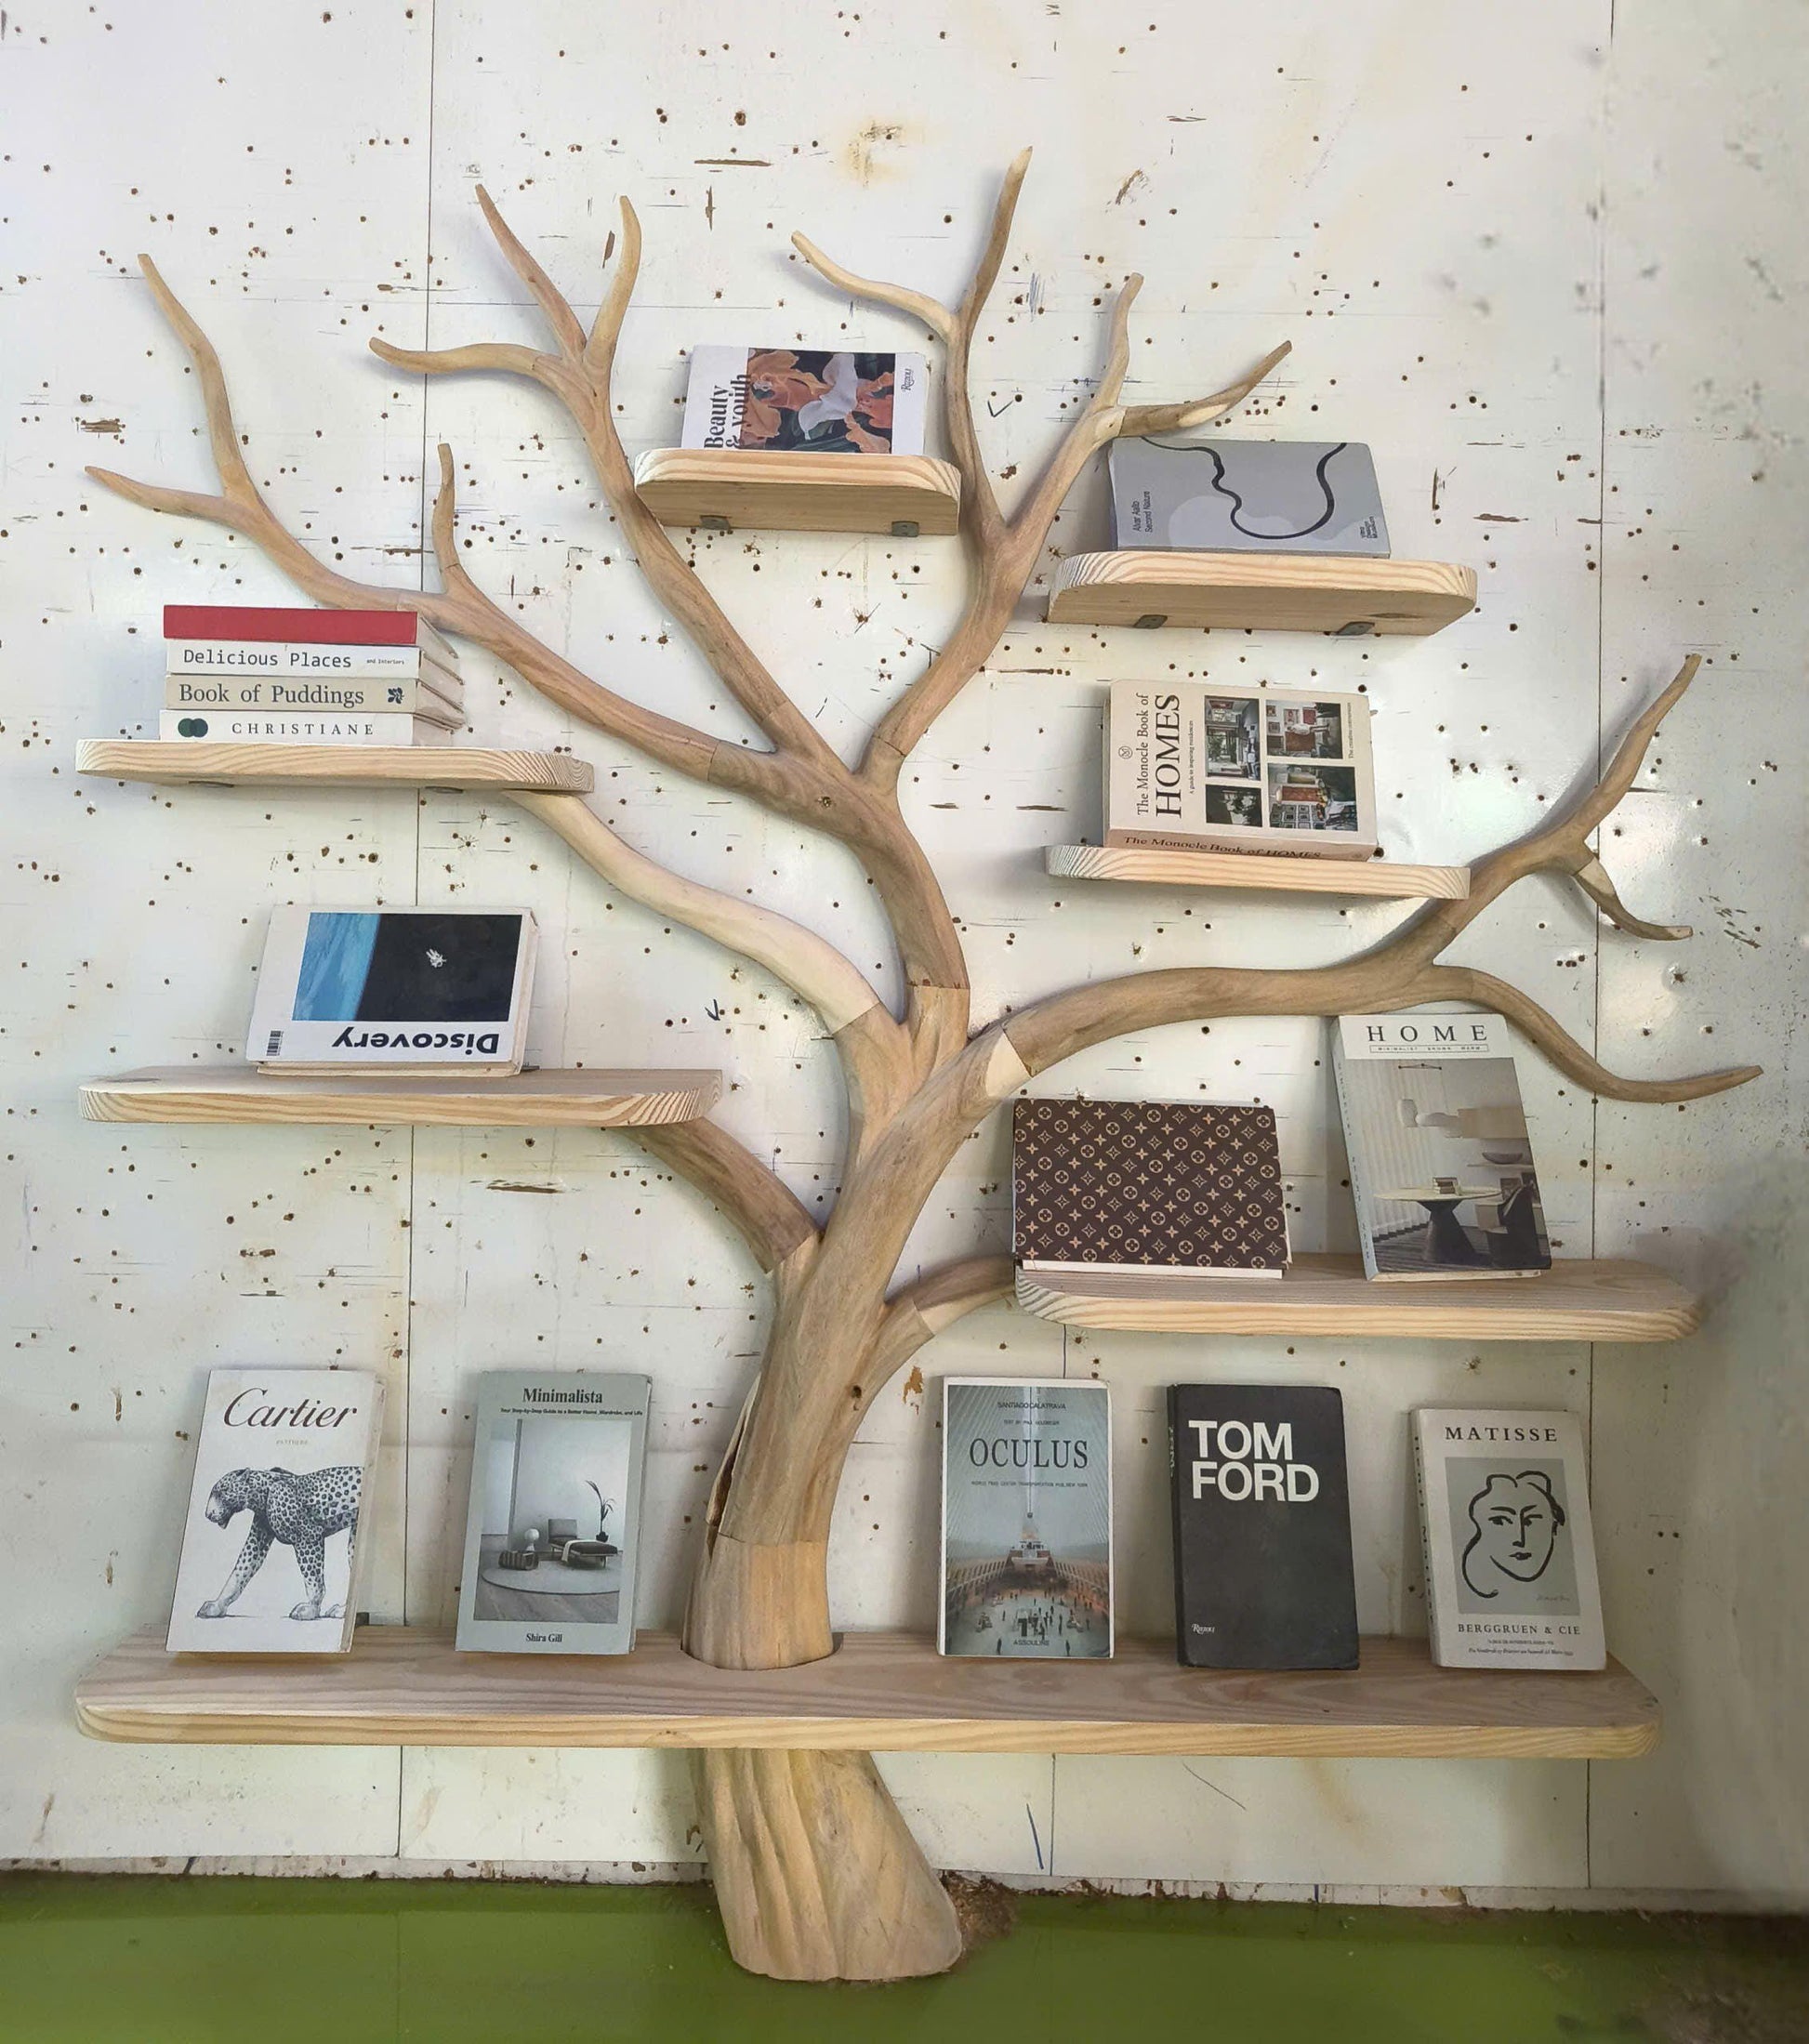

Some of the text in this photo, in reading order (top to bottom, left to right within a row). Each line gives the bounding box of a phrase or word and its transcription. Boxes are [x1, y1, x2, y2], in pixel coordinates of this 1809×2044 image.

[704, 385, 729, 449] Beauty
[726, 435, 741, 449] &
[1143, 511, 1153, 533] Second
[183, 649, 278, 666] Delicious
[290, 653, 351, 668] Places
[179, 683, 364, 707] Book of Puddings
[231, 723, 374, 735] CHRISTIANE
[1136, 692, 1149, 815] The Monocle Book of
[1155, 694, 1182, 819] HOMES
[1124, 837, 1322, 859] The Monocle Book of HOMES
[332, 1026, 499, 1055] Discovery
[1367, 1024, 1487, 1042] HOME
[522, 1388, 603, 1404] Minimalista
[224, 1388, 357, 1429] Cartier
[1188, 1419, 1293, 1461] TOM
[1445, 1426, 1557, 1442] MATISSE
[970, 1438, 1088, 1469] OCULUS
[1192, 1461, 1320, 1502] FORD
[525, 1633, 563, 1642] Shira Gill
[1458, 1624, 1538, 1634] BERGGRUEN
[1559, 1626, 1580, 1635] CIE
